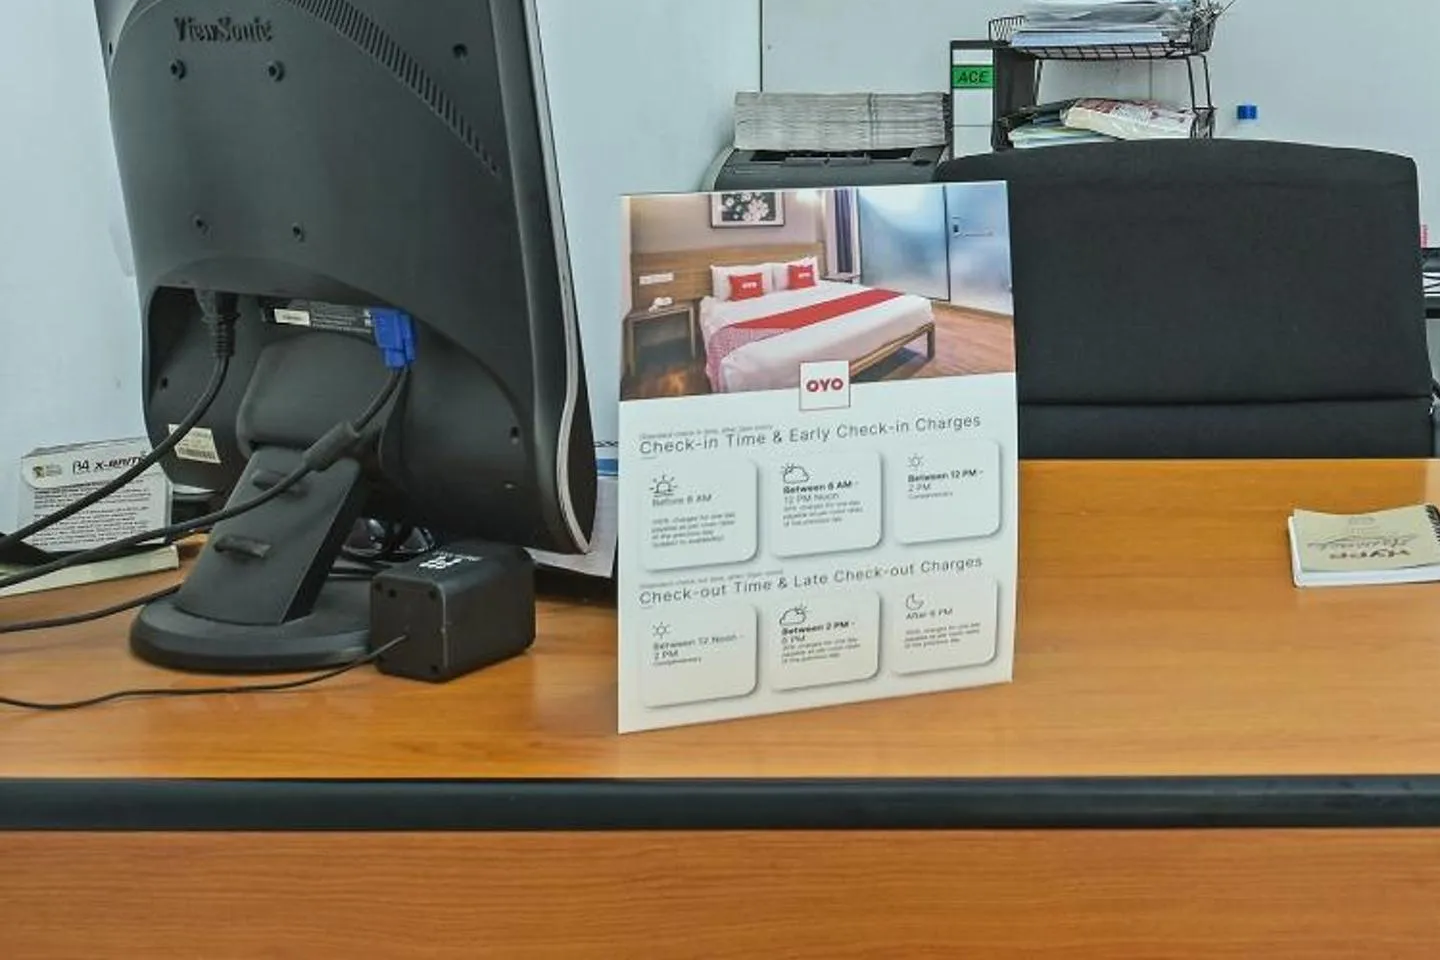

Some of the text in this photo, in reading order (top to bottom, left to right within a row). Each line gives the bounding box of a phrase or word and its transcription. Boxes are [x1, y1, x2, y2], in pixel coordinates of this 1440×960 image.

[174, 15, 272, 42] ViewSonic
[957, 70, 989, 85] ACE
[805, 376, 844, 393] OYO
[639, 437, 719, 455] Check-in
[727, 431, 766, 448] Time
[772, 430, 782, 443] &
[789, 427, 830, 443] Early
[836, 420, 909, 439] Check-in
[915, 414, 981, 432] Charges
[907, 473, 949, 483] Between
[951, 471, 961, 480] 12
[962, 469, 977, 478] PM
[783, 484, 826, 496] Between
[836, 480, 853, 490] AM
[916, 482, 931, 492] PM
[696, 494, 712, 504] AM
[639, 584, 728, 605] Check-out
[735, 580, 772, 594] Time
[777, 578, 788, 589] &
[794, 574, 828, 587] Late
[834, 563, 915, 584] Check-out
[921, 557, 983, 575] Charges
[905, 611, 927, 620] After
[938, 608, 953, 617] PM
[781, 624, 824, 636] Between
[833, 620, 849, 630] PM
[653, 640, 696, 651] Between
[661, 650, 679, 659] PM
